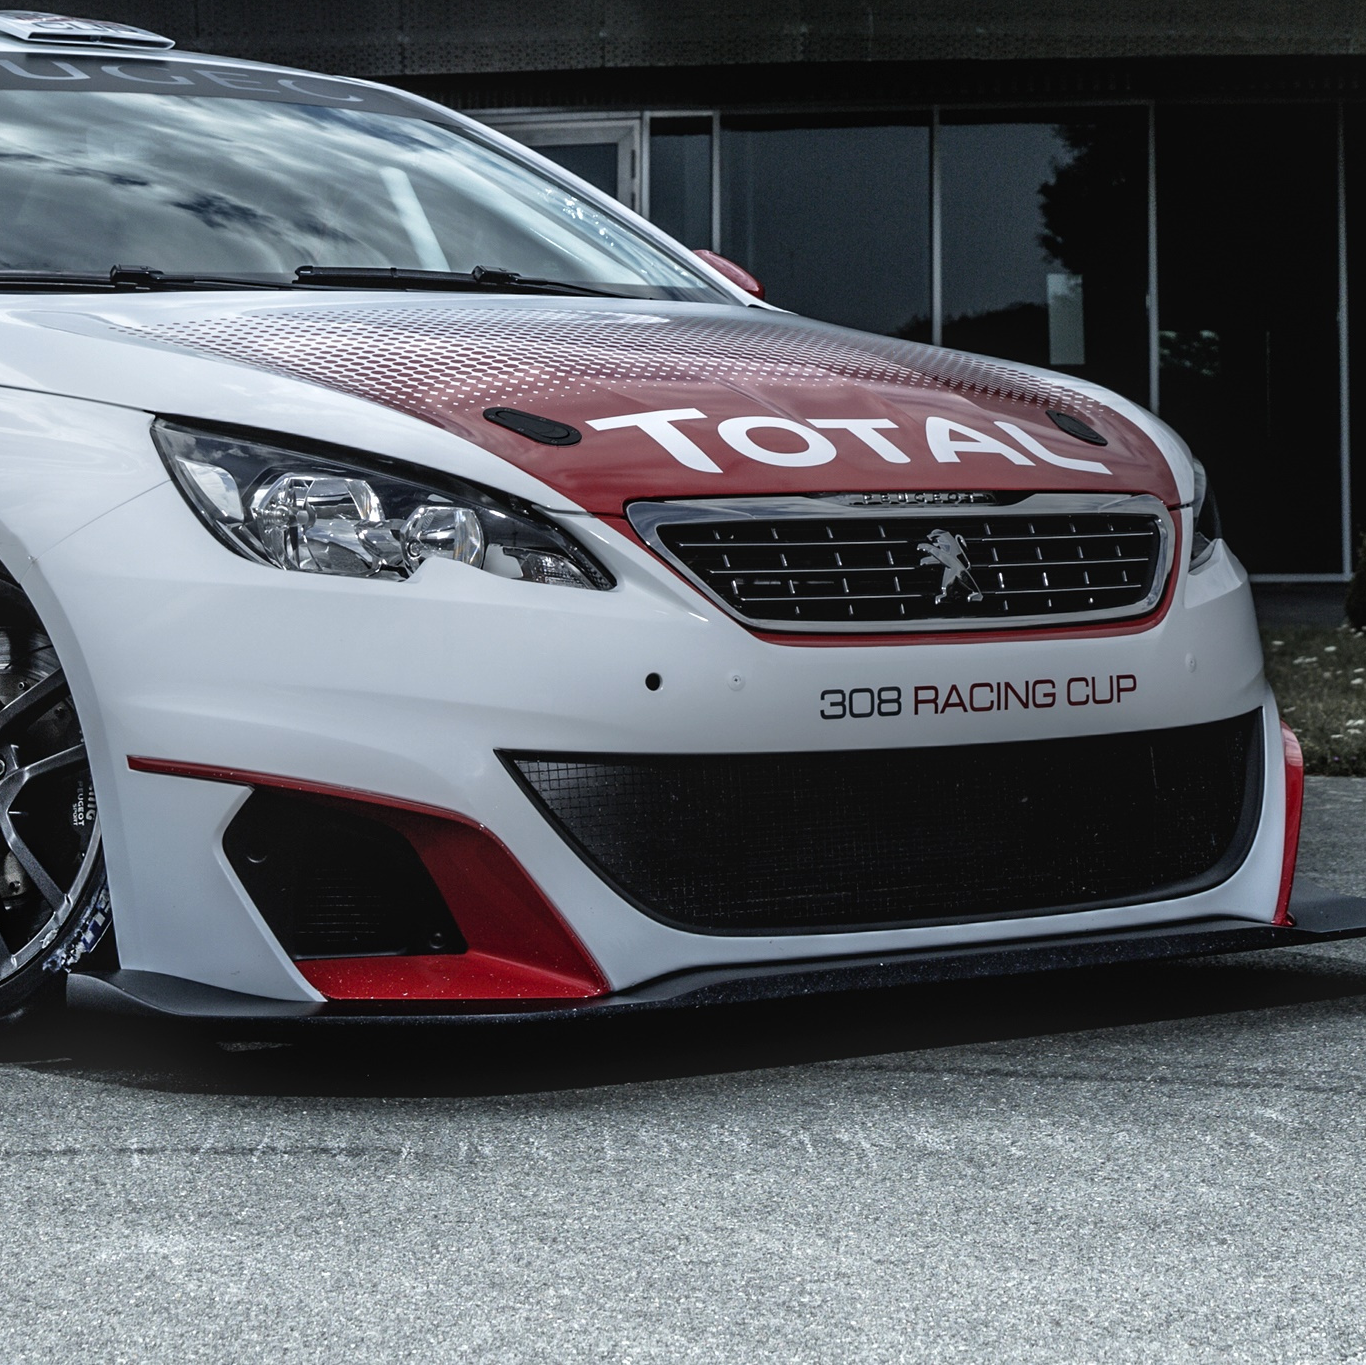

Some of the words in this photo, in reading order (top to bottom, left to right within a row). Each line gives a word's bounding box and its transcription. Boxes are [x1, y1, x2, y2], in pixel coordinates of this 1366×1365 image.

[585, 408, 1113, 475] TOTAL
[863, 492, 983, 504] PEUGEOT
[820, 686, 902, 720] 308
[914, 679, 1056, 715] RACING
[1066, 674, 1137, 707] CUP
[77, 780, 85, 826] PEUGEOT
